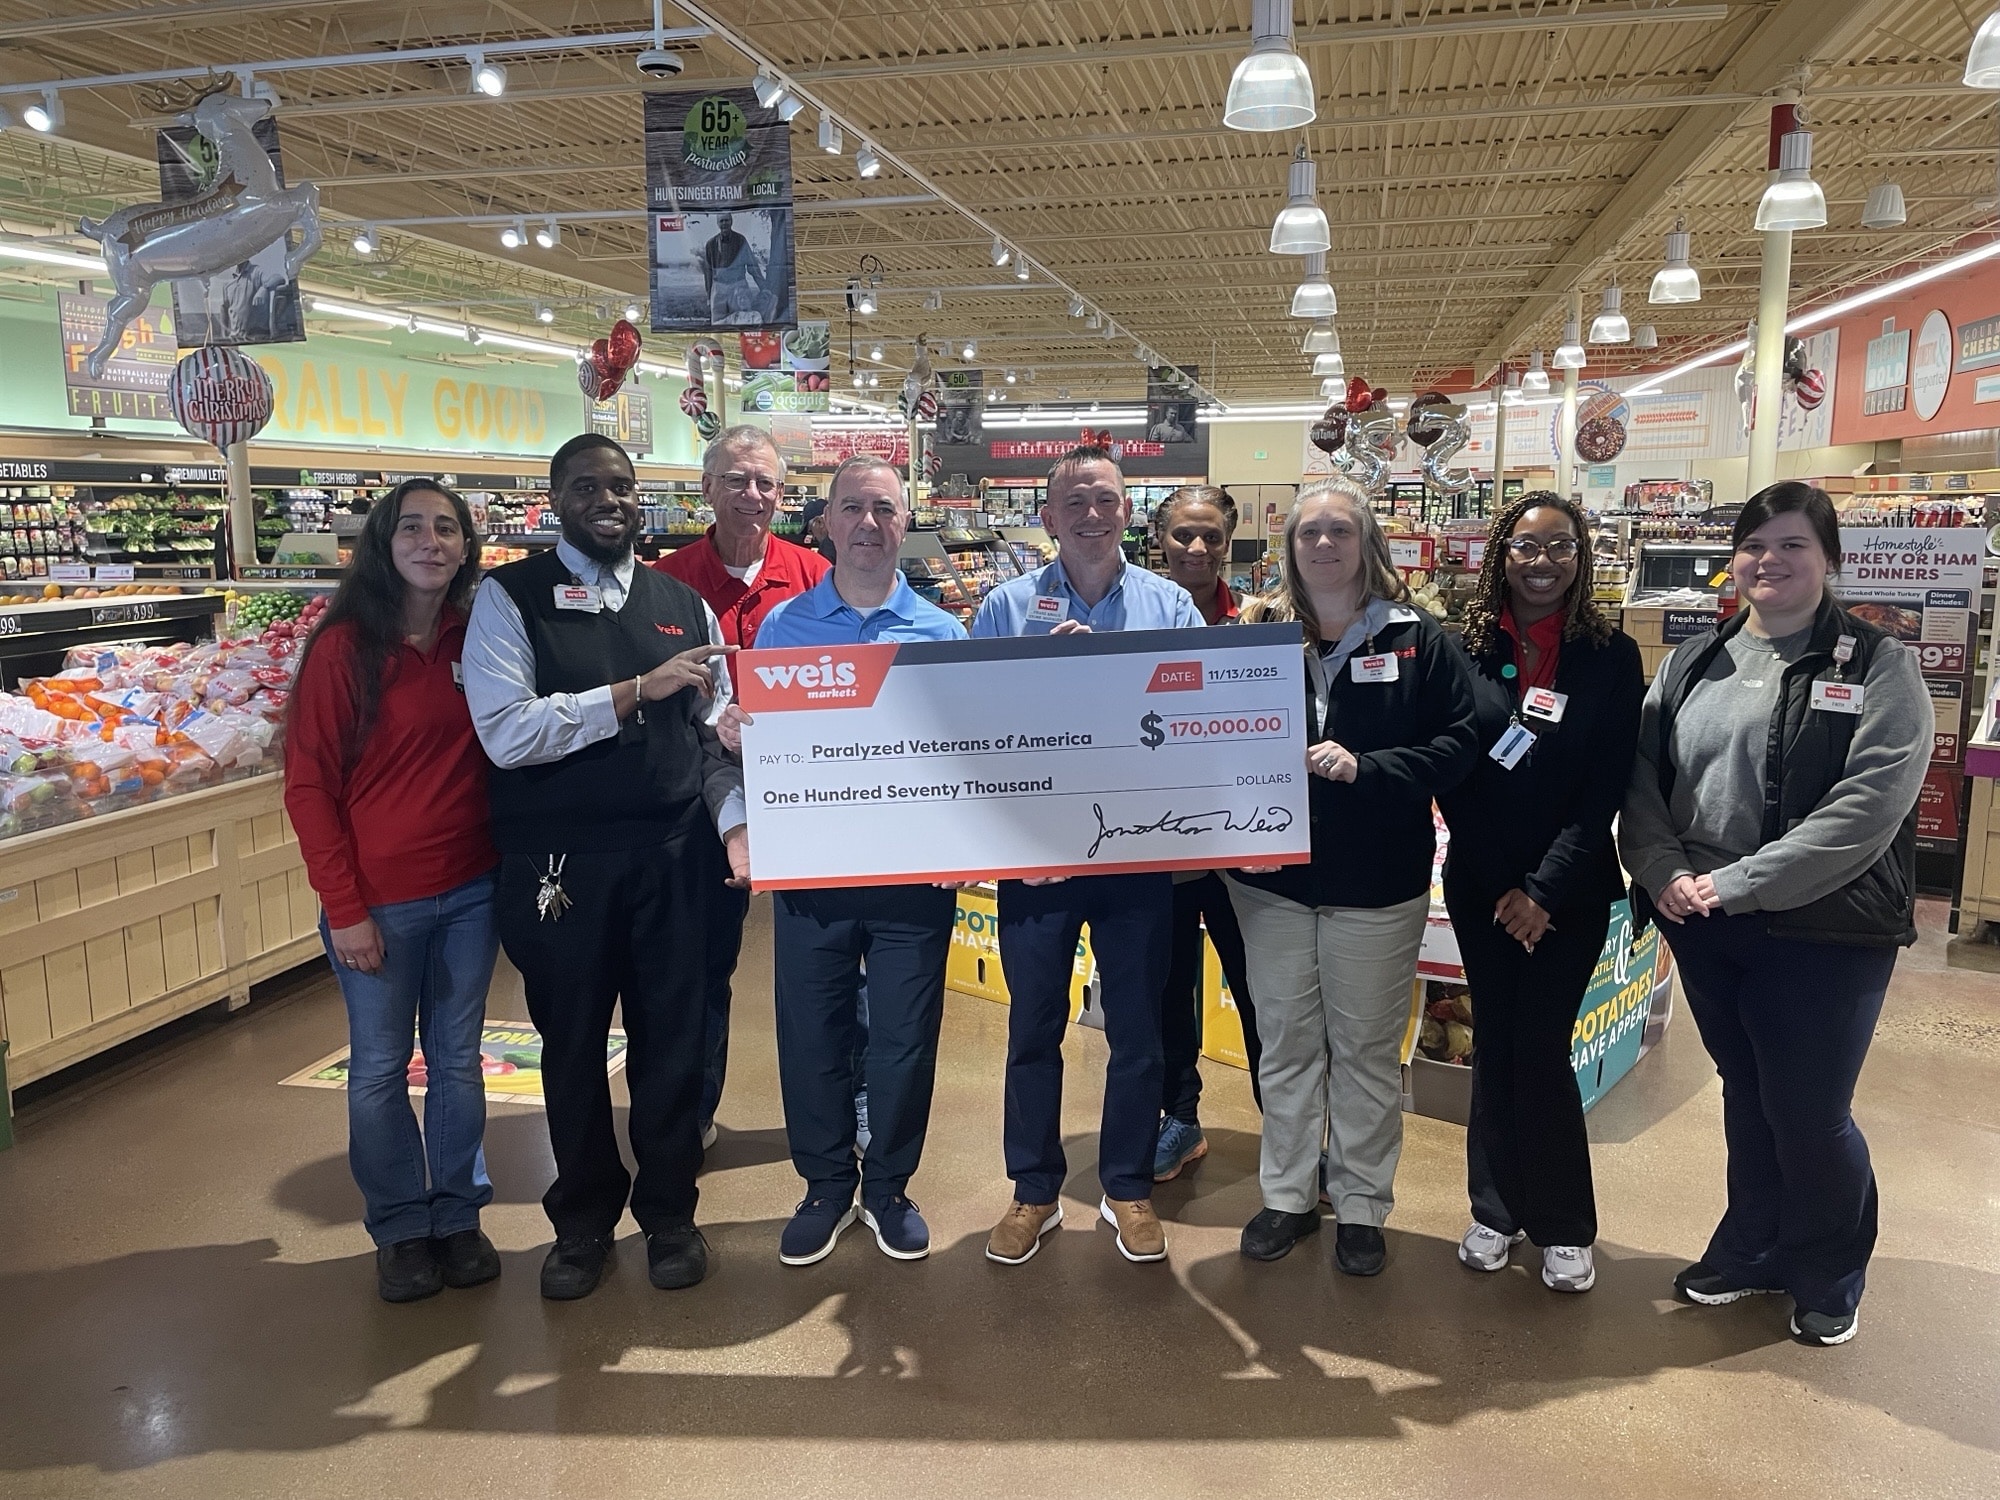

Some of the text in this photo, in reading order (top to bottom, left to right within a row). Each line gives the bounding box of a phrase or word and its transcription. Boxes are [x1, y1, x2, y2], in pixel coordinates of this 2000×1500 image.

[701, 136, 730, 150] YEAR
[684, 150, 748, 172] partnership
[655, 186, 742, 200] HUNTSINGER FARM
[753, 182, 777, 196] LOCAL
[133, 194, 233, 235] Happy Holidays
[1867, 361, 1905, 390] BOLD
[776, 390, 826, 409] organic
[1864, 394, 1905, 415] Cheese
[433, 376, 546, 446] GOOD
[1011, 446, 1040, 455] GREAT
[173, 467, 206, 481] PREMIUM
[313, 473, 357, 484] FRESH HERBS
[1863, 535, 1937, 555] Homestyle
[1840, 553, 1977, 565] URKEY OR HAM
[1857, 568, 1939, 580] DINNERS
[1898, 590, 1921, 599] Turkey
[1669, 615, 1694, 623] fresh
[754, 655, 856, 690] weis
[1161, 667, 1278, 683] DATE: 11/13/2025
[807, 688, 857, 699] markets
[1827, 690, 1849, 698] weis
[759, 755, 781, 765] PAY
[785, 753, 804, 764] TO:
[812, 740, 905, 760] Paralyzed
[908, 738, 990, 754] Veterans
[994, 735, 1014, 749] of
[1017, 732, 1092, 748] America
[1169, 716, 1282, 738] 170,000.00
[763, 774, 1292, 804] One Hundred Seventy Thousand DOLLARS
[1571, 967, 1652, 1050] POTATOES
[1570, 1034, 1606, 1073] HAVE
